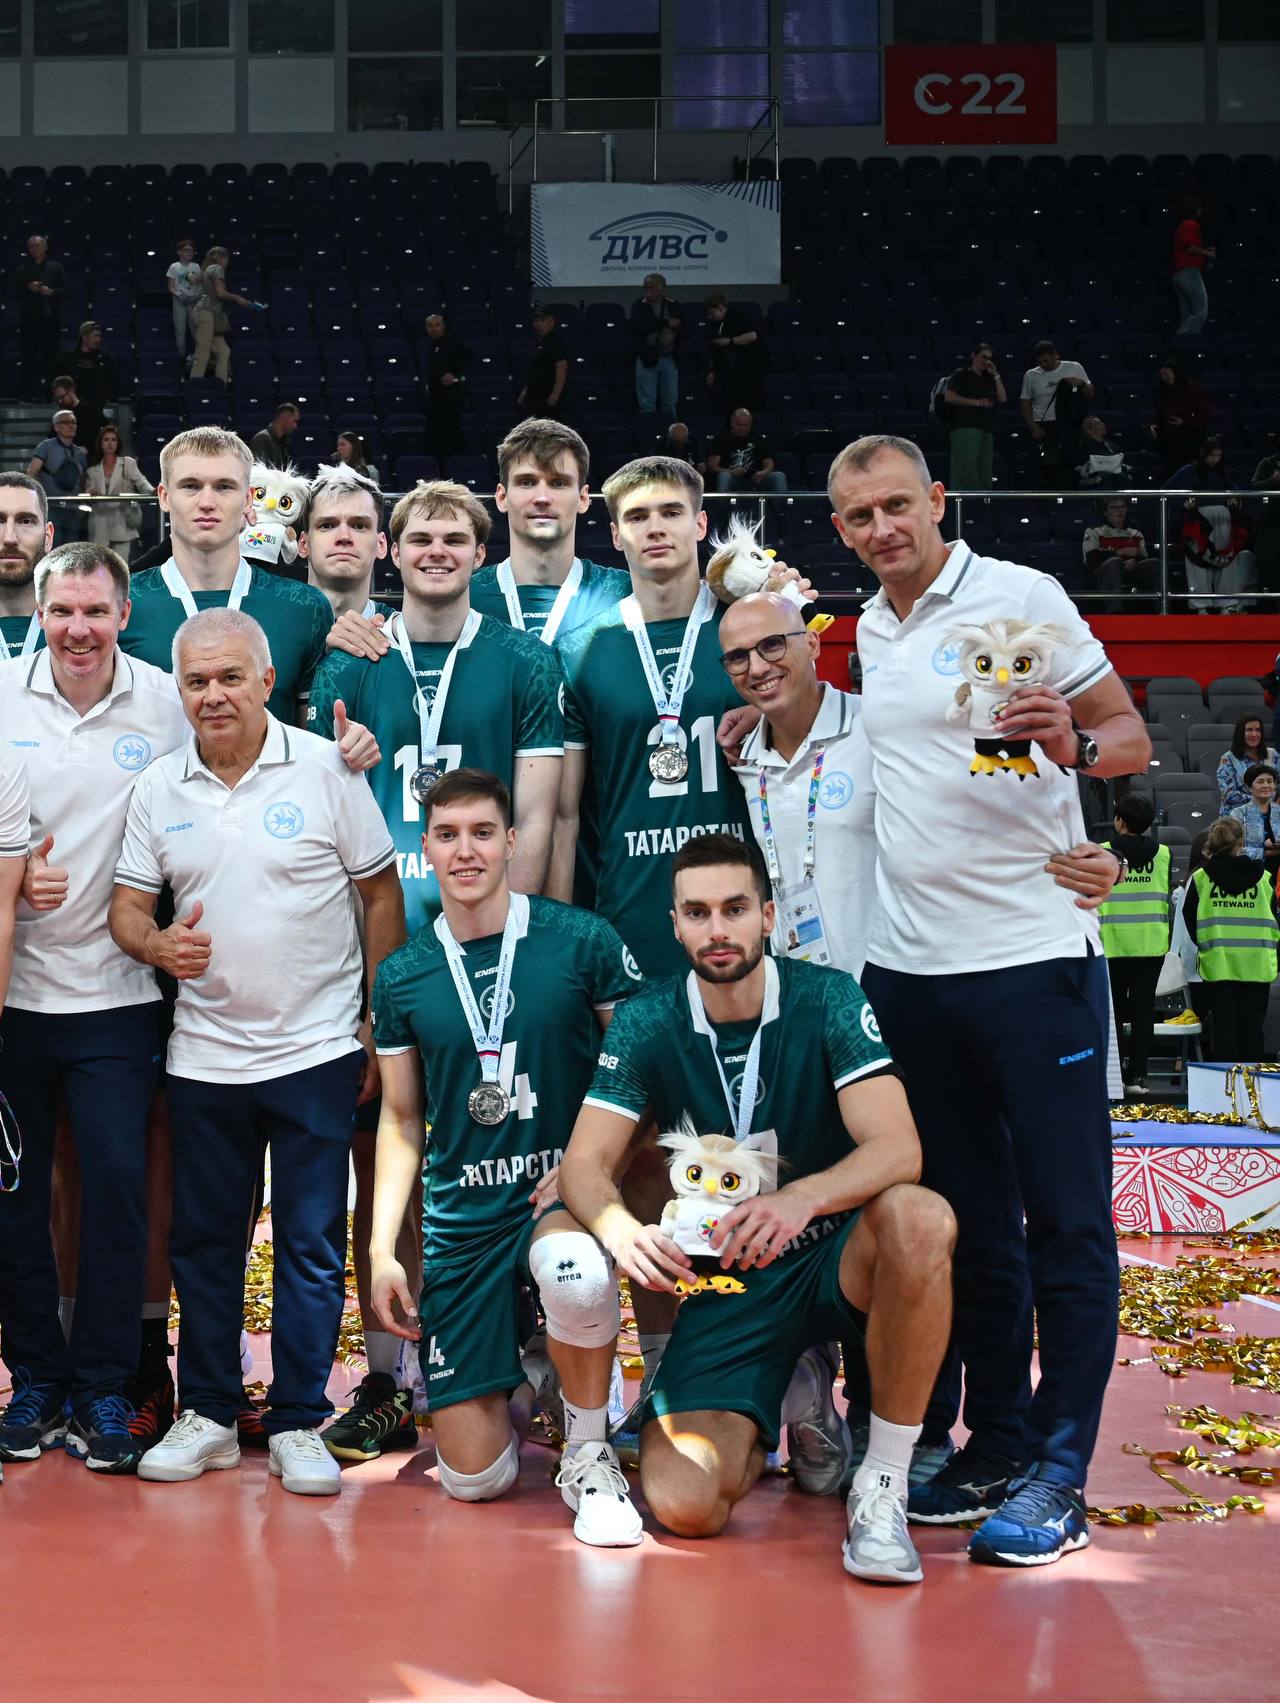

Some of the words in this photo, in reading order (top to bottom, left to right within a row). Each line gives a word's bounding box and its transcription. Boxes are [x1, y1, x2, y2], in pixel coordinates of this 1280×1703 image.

[602, 234, 710, 264] ДИВС
[656, 647, 684, 655] ENSE
[165, 822, 194, 833] ENSEN
[1212, 900, 1255, 909] STEWARD
[724, 1054, 748, 1064] ENS
[1059, 1048, 1094, 1065] ENSEN
[498, 1041, 538, 1120] 4
[459, 1148, 566, 1188] ТАТАРСТА
[428, 1335, 446, 1366] 4
[429, 1368, 456, 1381] ENSEN
